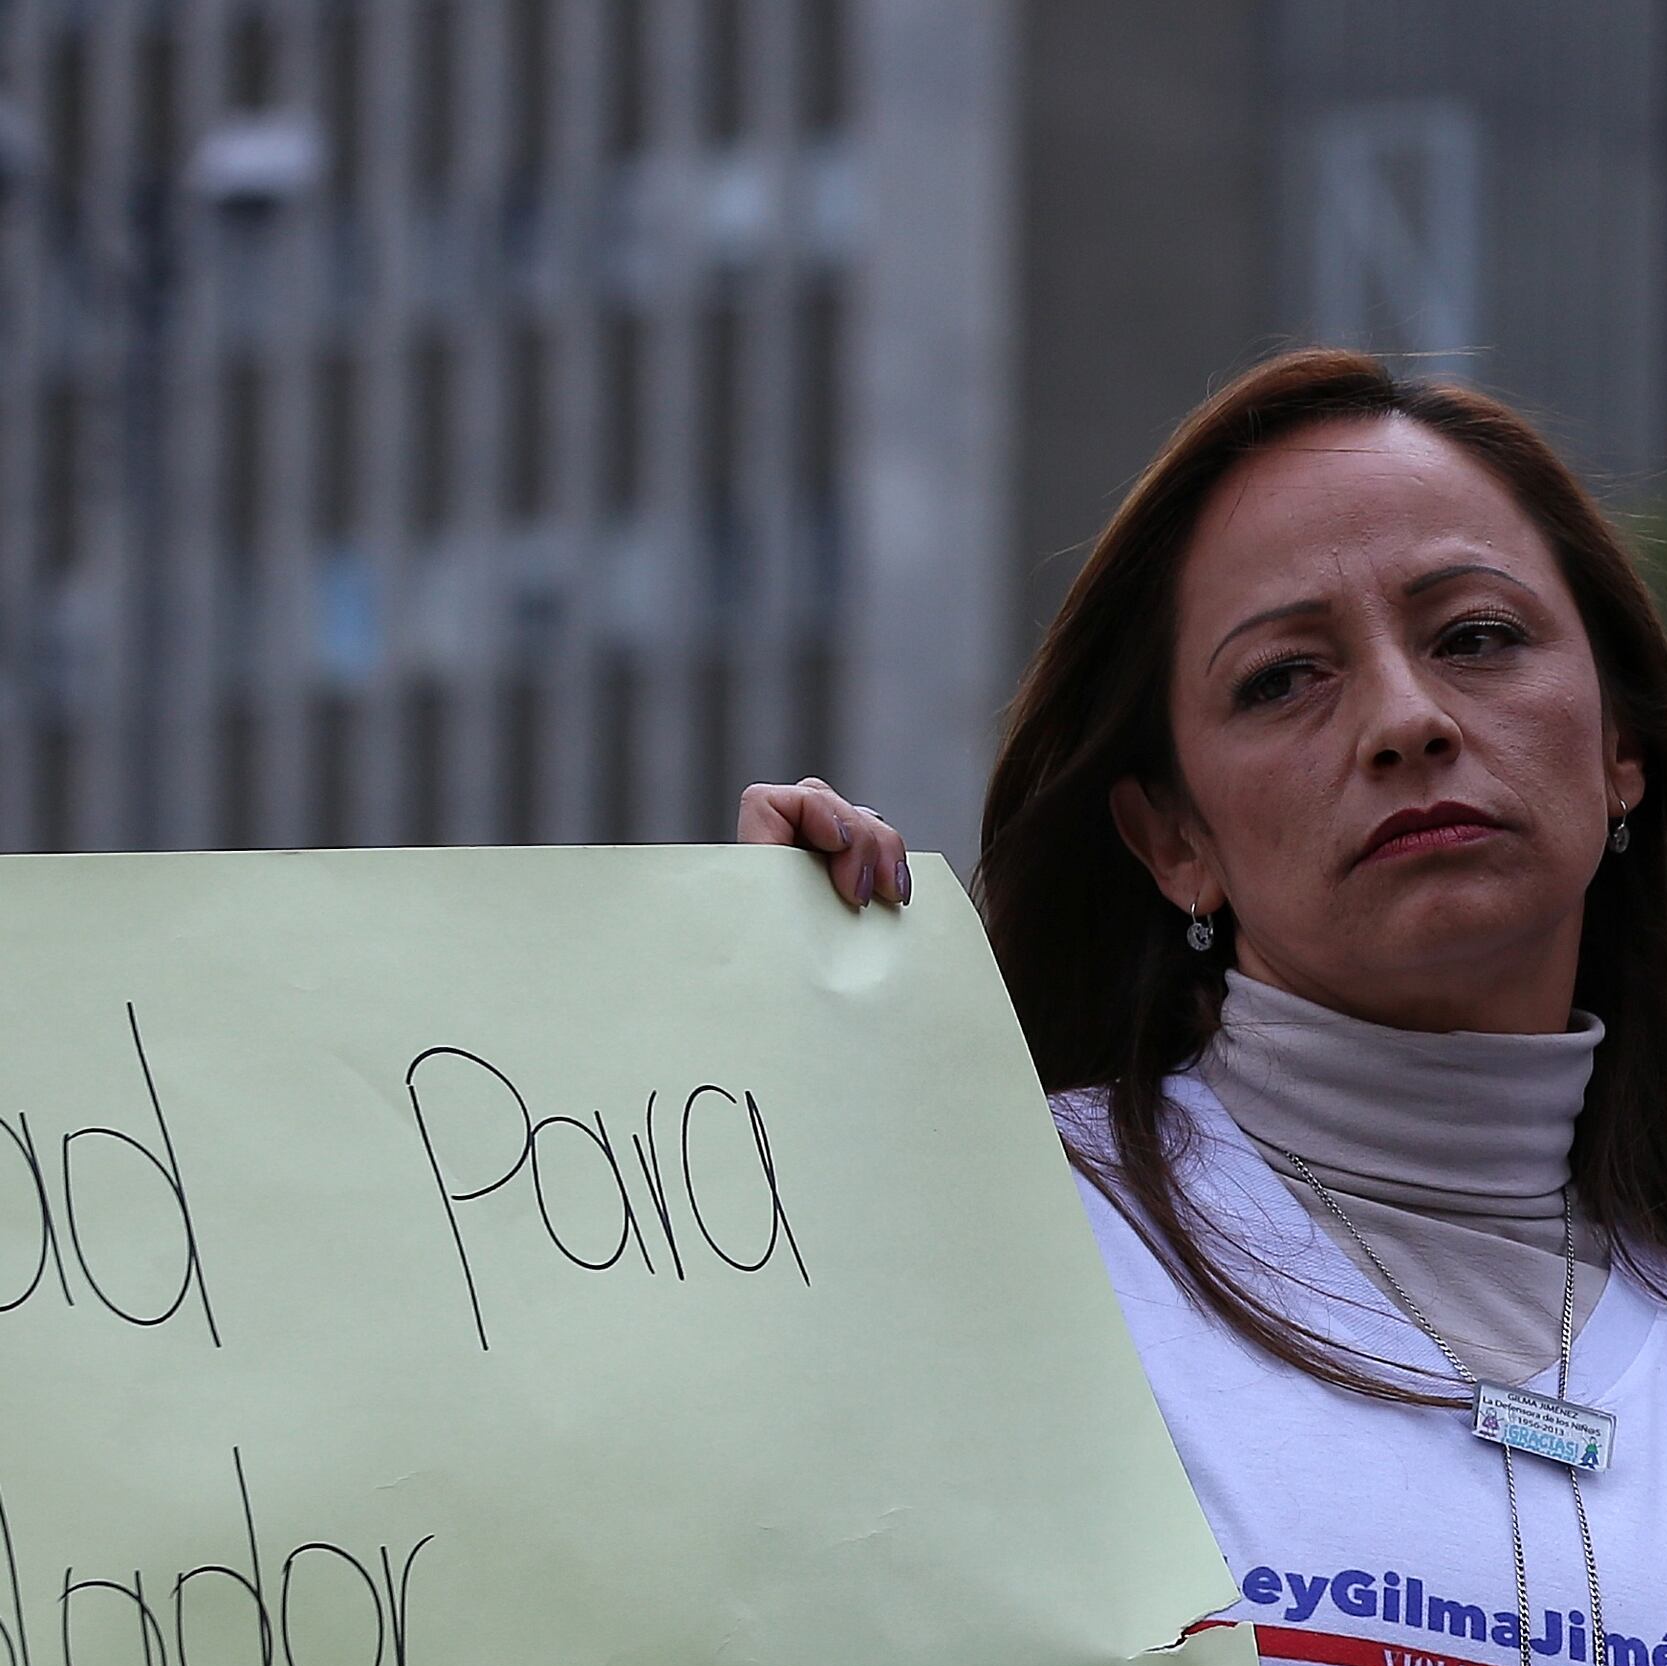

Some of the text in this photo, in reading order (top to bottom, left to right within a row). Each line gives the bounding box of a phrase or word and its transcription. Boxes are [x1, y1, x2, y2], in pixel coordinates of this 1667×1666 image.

[407, 1046, 811, 1351] Para
[1482, 1395, 1494, 1408] La
[1495, 1400, 1541, 1420] Defensora
[1542, 1412, 1555, 1424] de
[1557, 1417, 1570, 1428] los
[1507, 1393, 1538, 1409] GILMA
